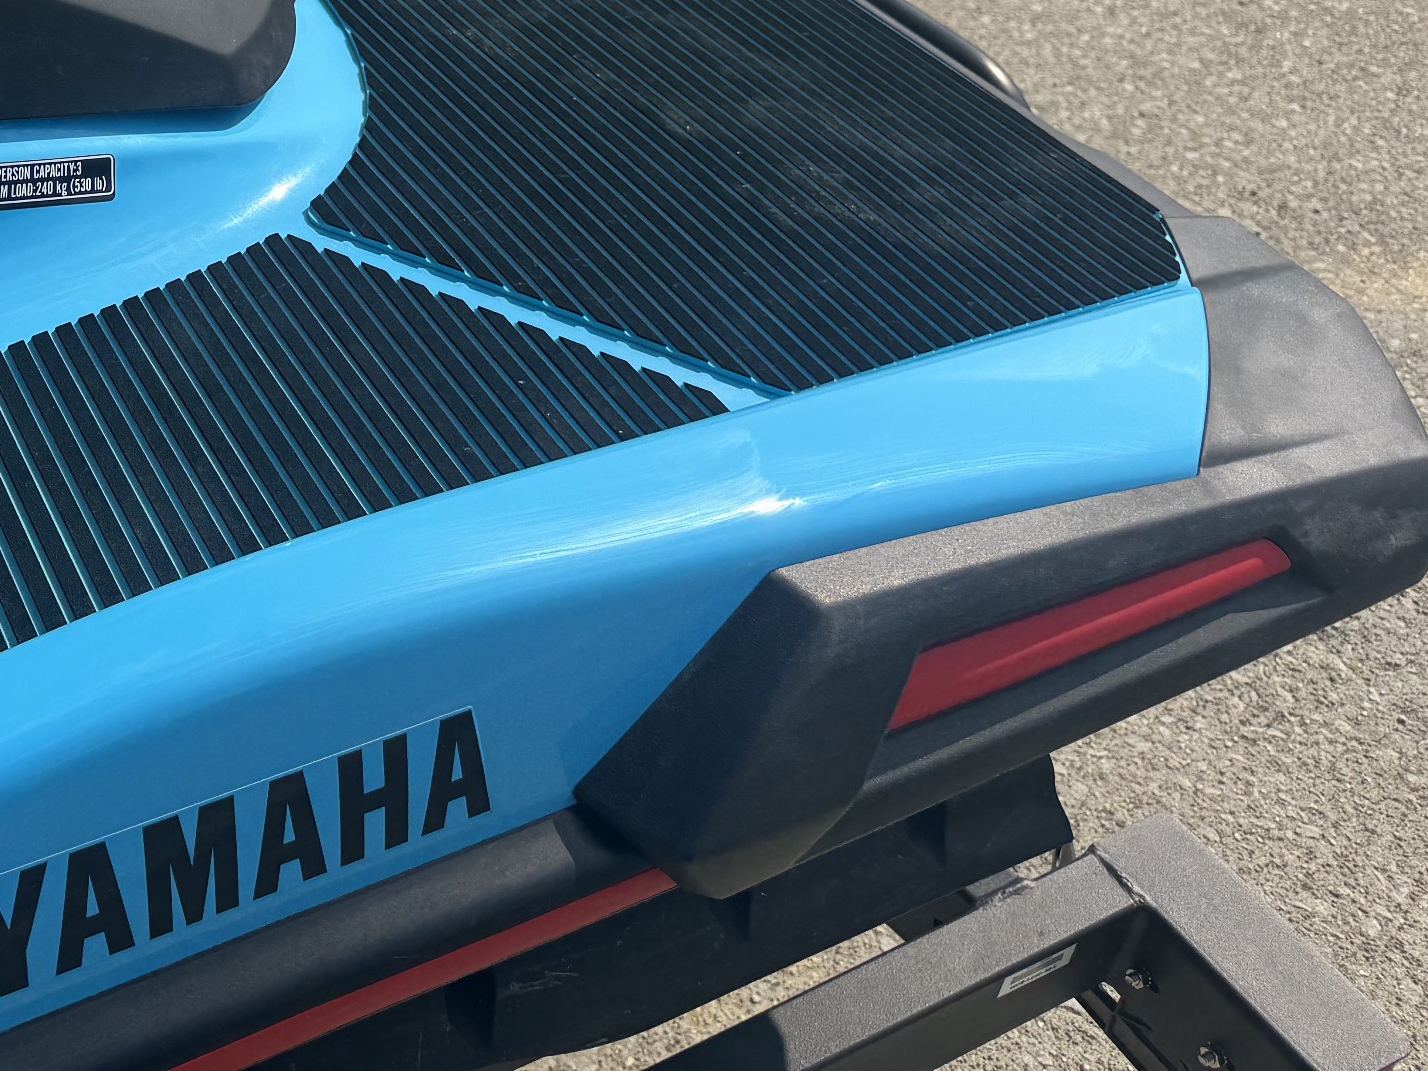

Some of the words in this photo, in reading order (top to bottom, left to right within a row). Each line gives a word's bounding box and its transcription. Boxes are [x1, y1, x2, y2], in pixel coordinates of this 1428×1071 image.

[33, 161, 82, 179] CAPACITY:3
[11, 180, 54, 198] LOAD:240
[56, 180, 68, 197] kg
[70, 177, 92, 194] (530
[94, 175, 107, 192] lb)
